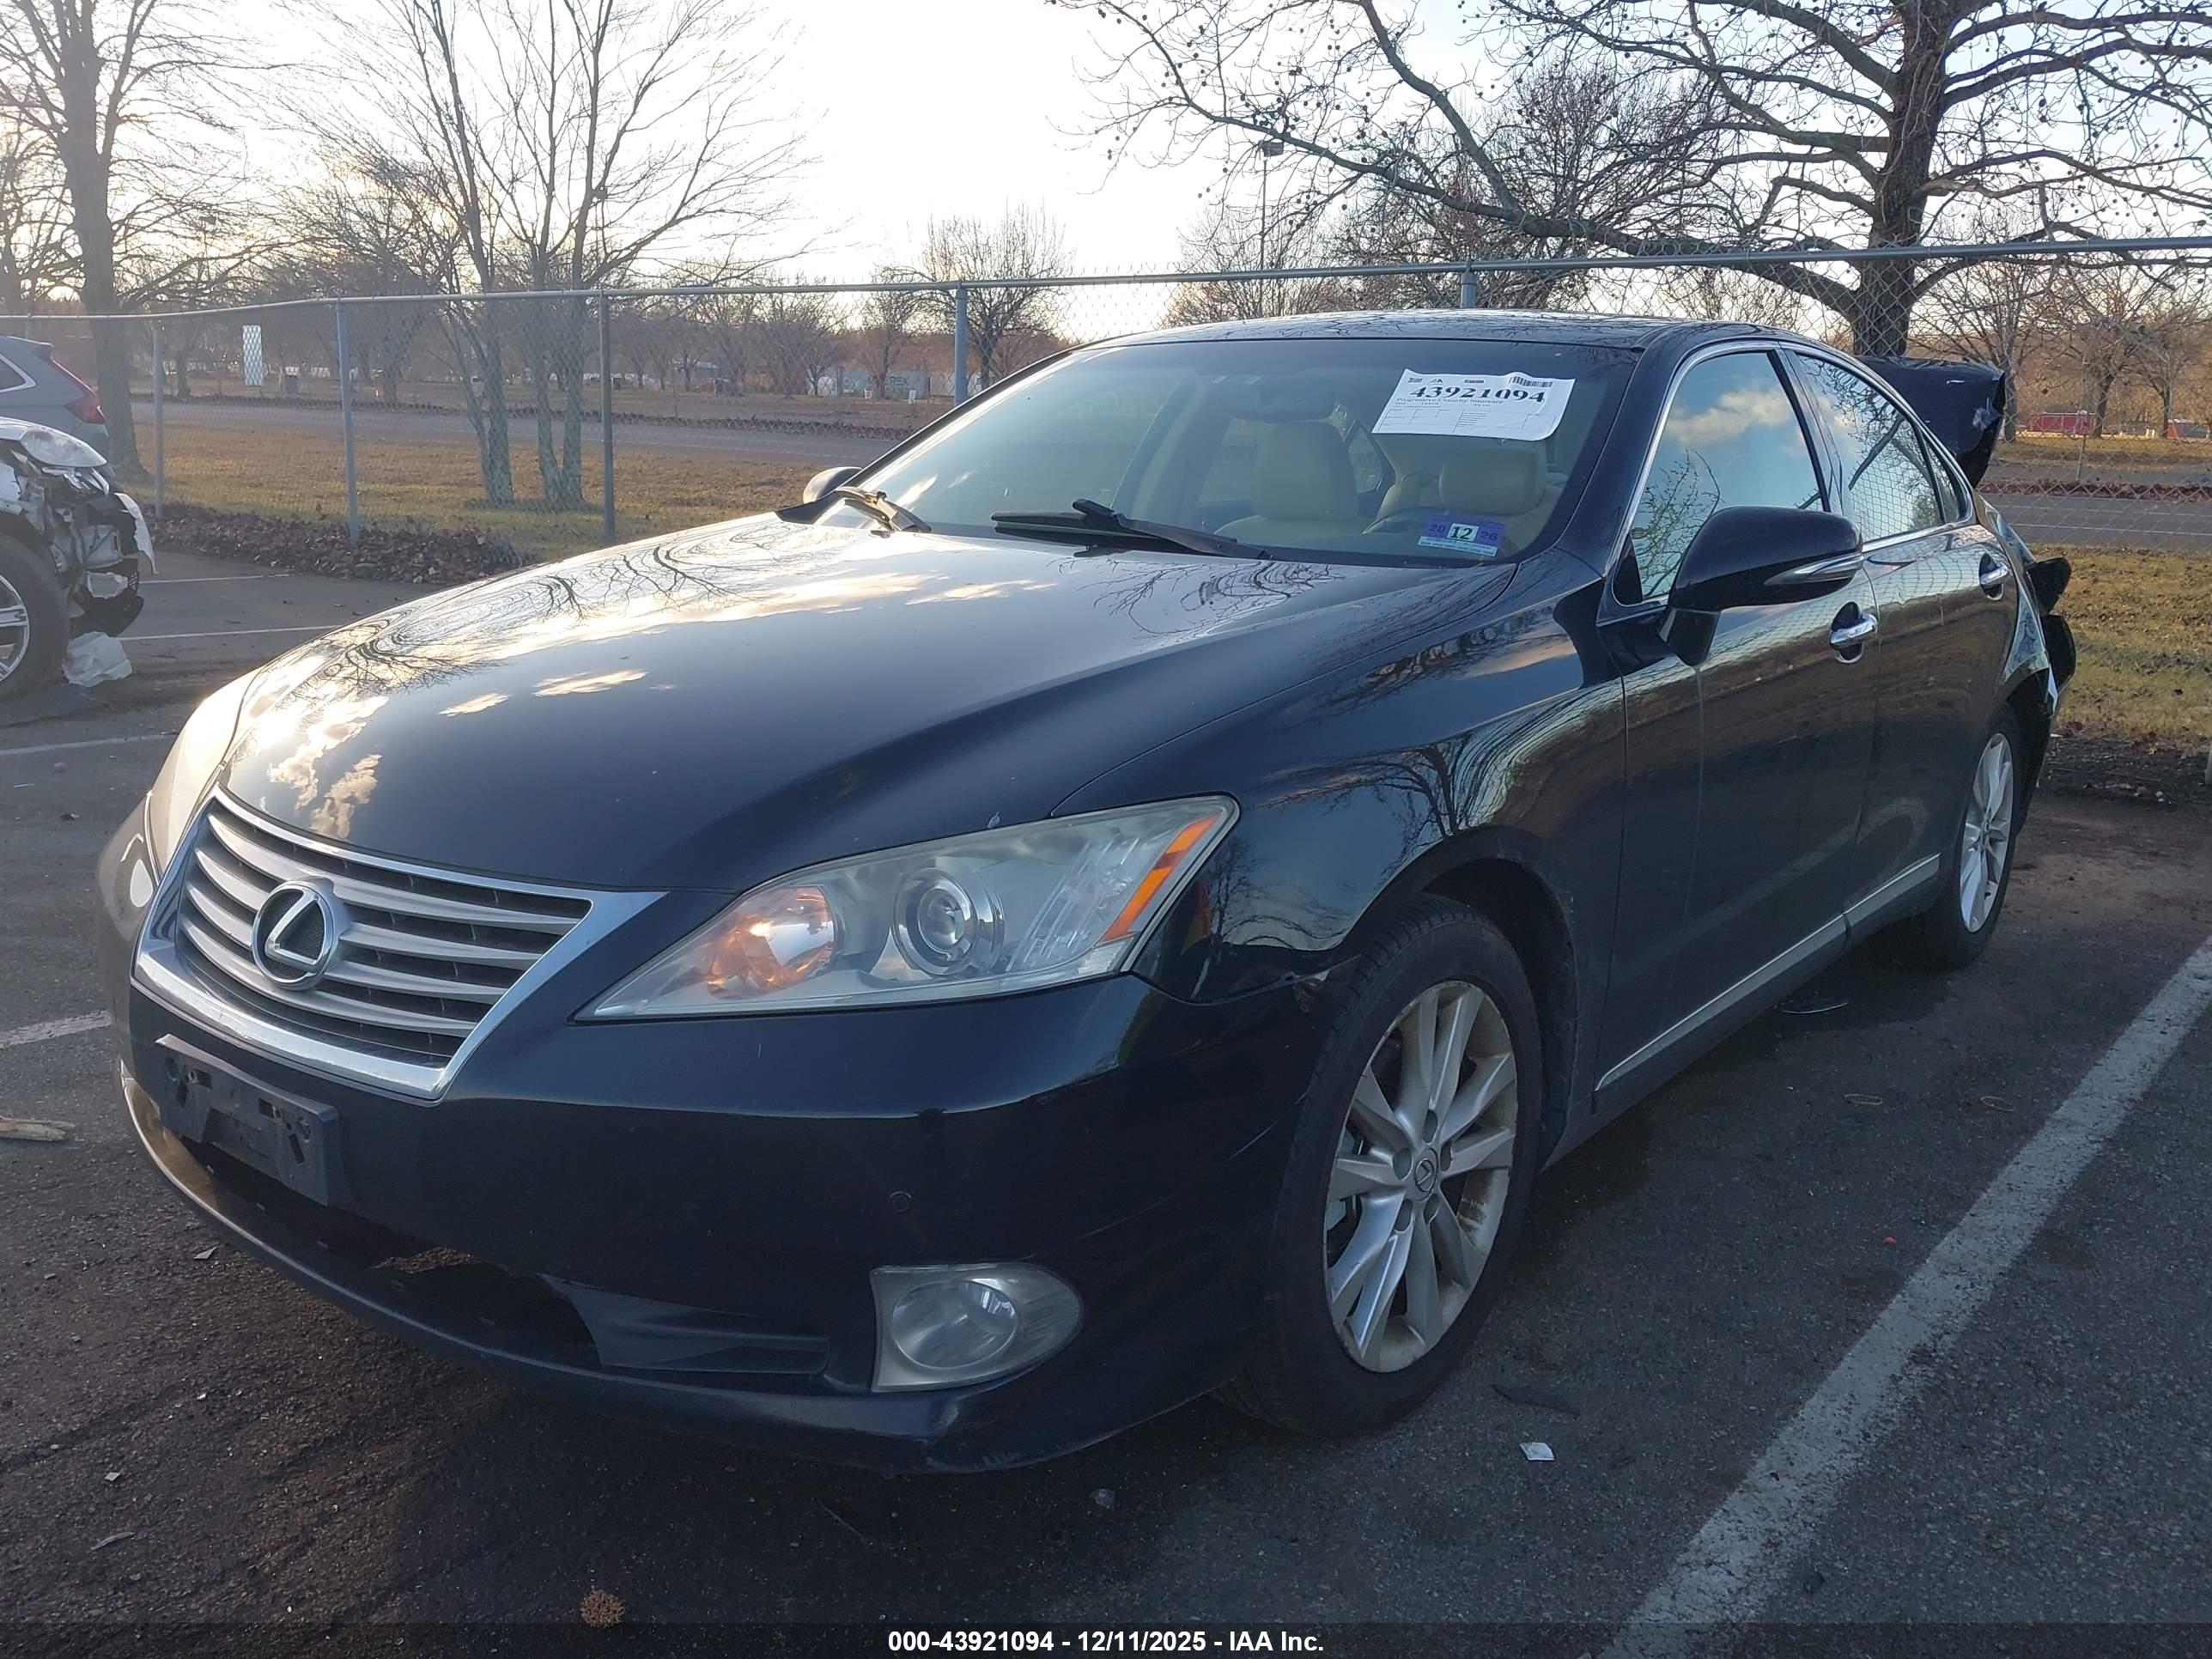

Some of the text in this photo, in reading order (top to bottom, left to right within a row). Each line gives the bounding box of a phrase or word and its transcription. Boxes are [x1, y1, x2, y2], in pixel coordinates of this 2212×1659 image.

[1409, 386, 1546, 403] 43921094
[1449, 526, 1474, 540] 12
[1480, 532, 1498, 542] 26
